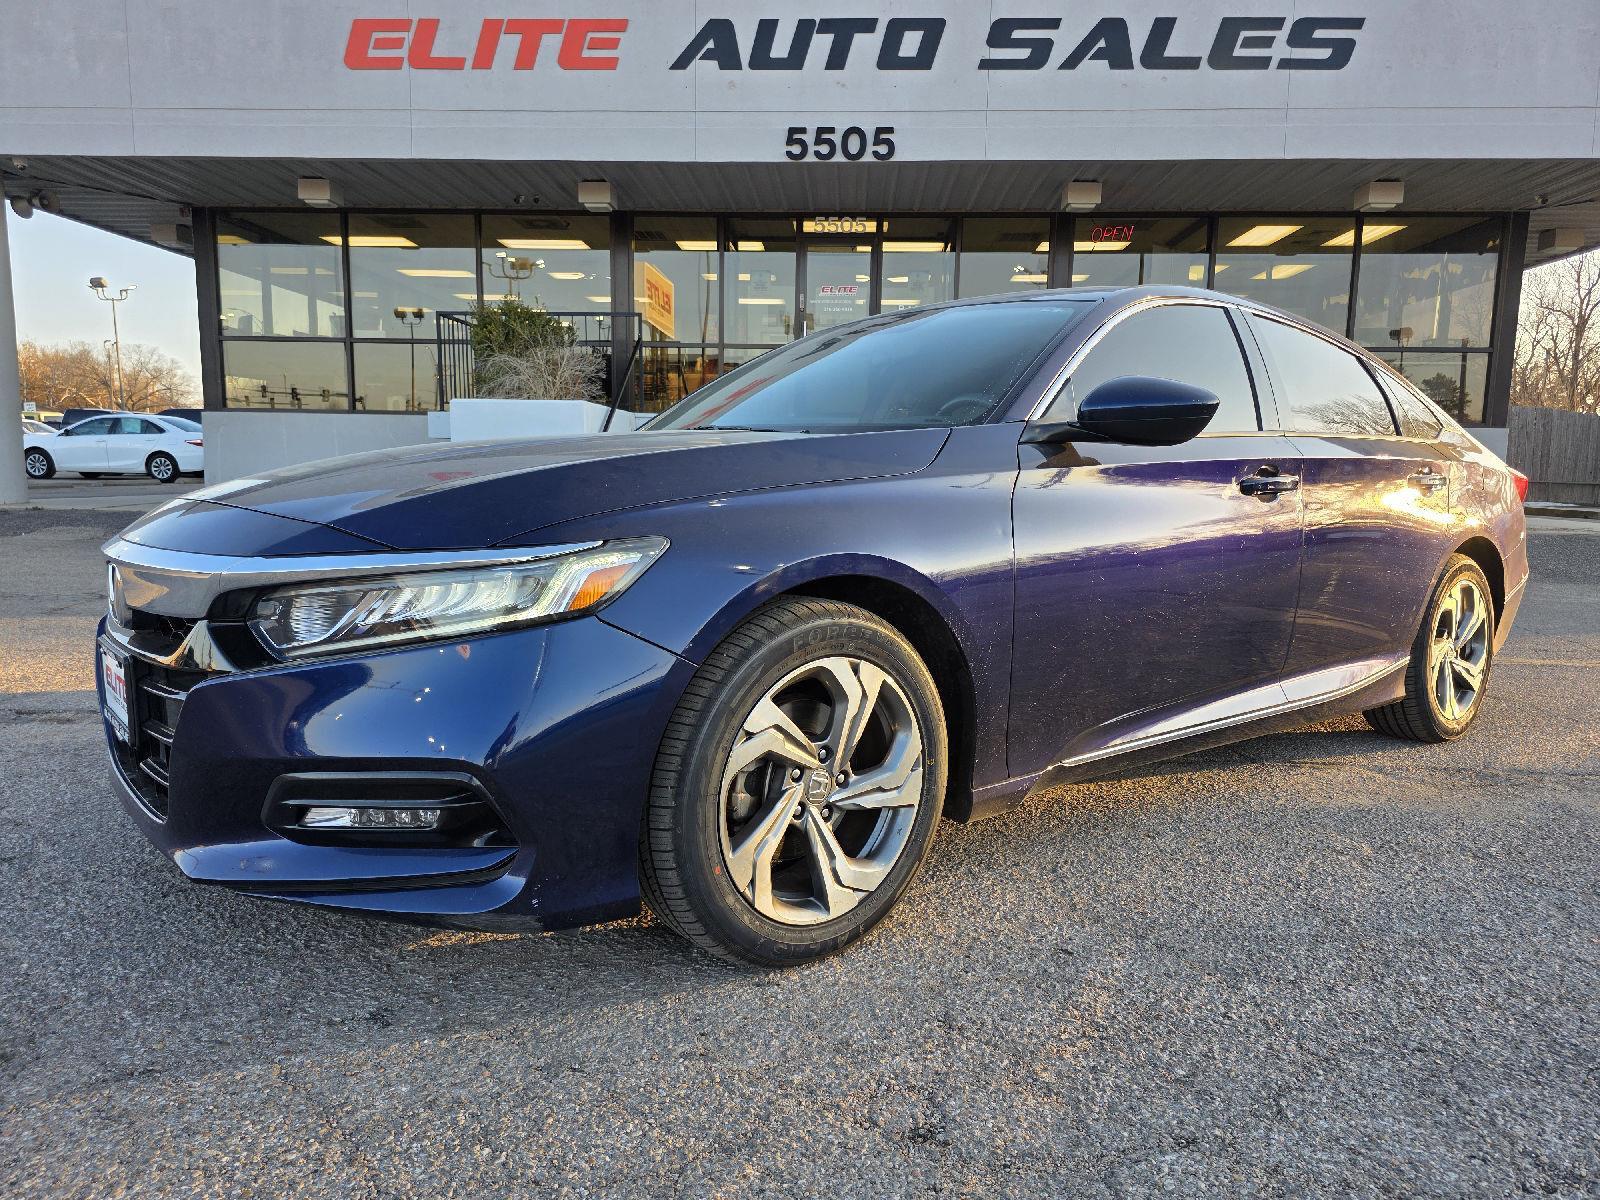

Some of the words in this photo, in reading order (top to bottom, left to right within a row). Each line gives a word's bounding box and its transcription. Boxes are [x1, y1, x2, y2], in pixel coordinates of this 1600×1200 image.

[343, 18, 629, 70] ELITE
[668, 17, 947, 71] AUTO
[977, 16, 1366, 70] SALES
[785, 126, 896, 161] 5505
[814, 216, 867, 233] 5505
[1091, 225, 1135, 243] OPEN
[821, 285, 859, 294] ELITE
